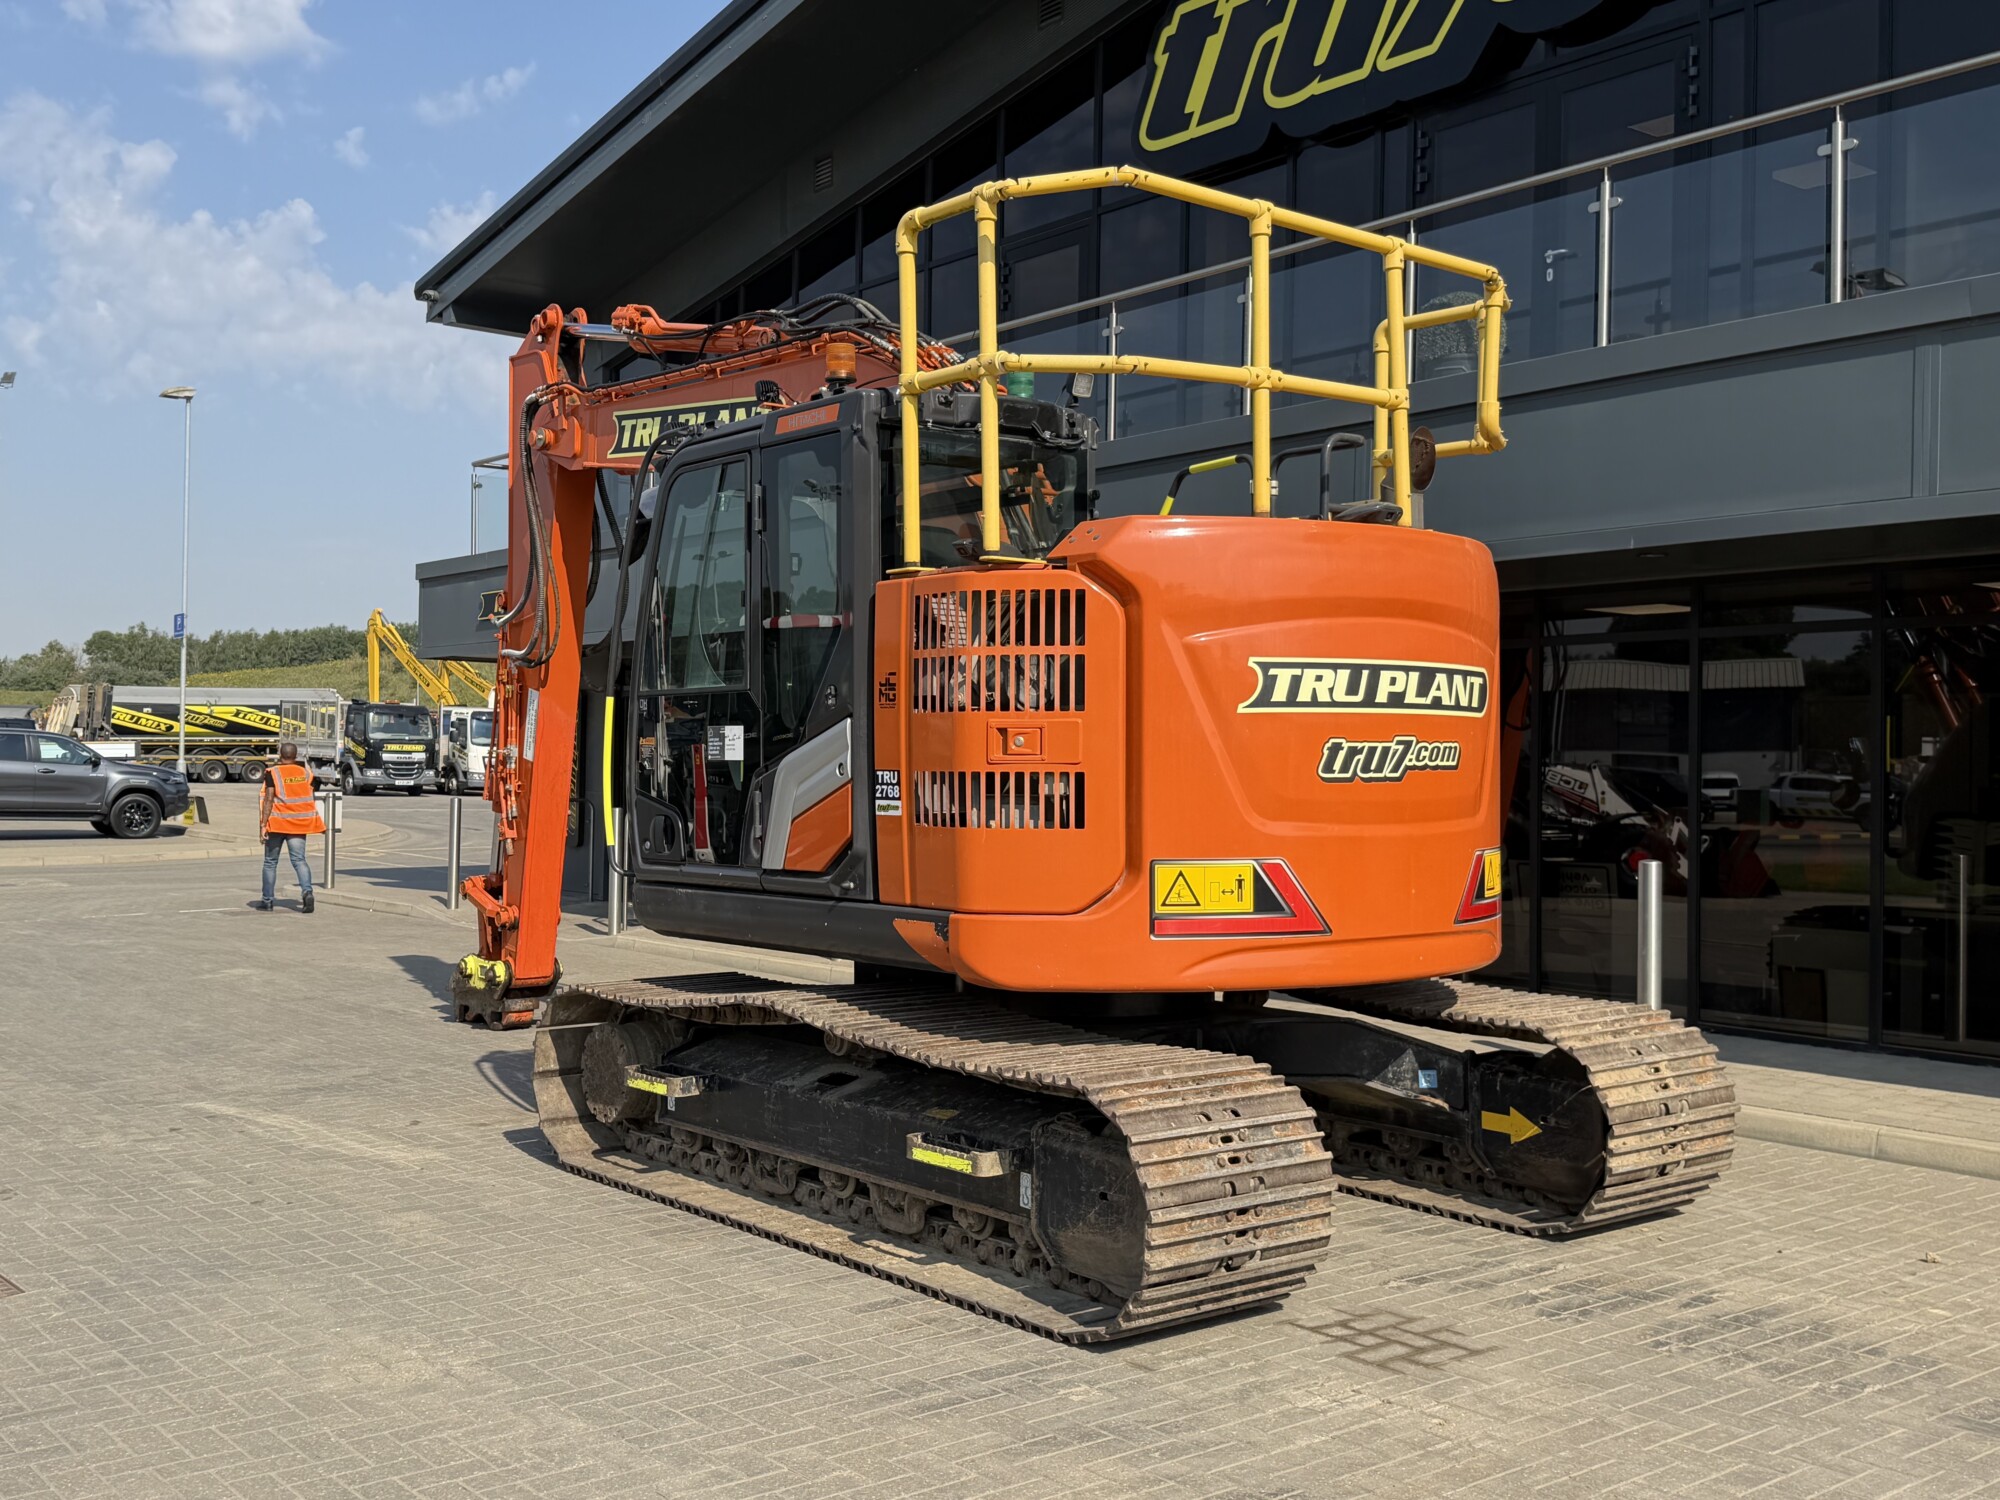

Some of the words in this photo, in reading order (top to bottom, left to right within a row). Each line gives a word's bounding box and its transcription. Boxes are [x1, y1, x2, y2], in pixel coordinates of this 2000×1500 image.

[788, 410, 827, 428] HITACHI
[1267, 668, 1370, 703] TRU
[1374, 670, 1484, 709] PLANT
[112, 710, 138, 725] RU
[137, 717, 170, 732] MIX
[236, 709, 269, 724] TRU
[1318, 735, 1461, 781] tru7.com
[876, 771, 898, 784] TRU
[875, 785, 900, 798] 2768
